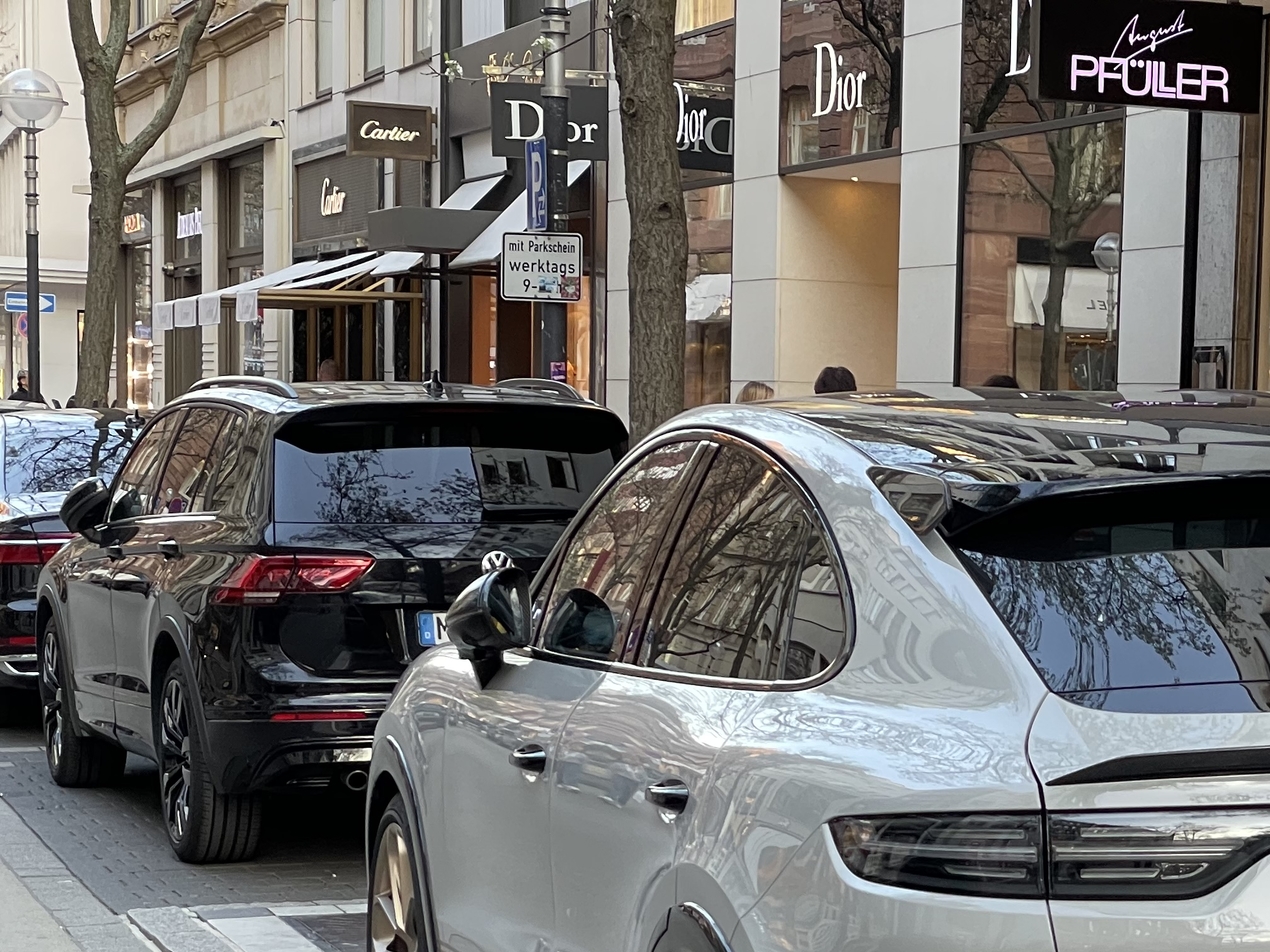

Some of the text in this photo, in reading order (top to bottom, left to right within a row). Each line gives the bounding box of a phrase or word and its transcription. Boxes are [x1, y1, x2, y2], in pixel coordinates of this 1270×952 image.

[813, 42, 866, 117] Dior
[1071, 54, 1229, 103] PFÜLLER
[360, 120, 420, 142] Cartier
[505, 100, 598, 143] Dor
[321, 178, 346, 217] Cartier
[509, 240, 576, 254] mit Parkschein
[509, 259, 575, 277] werktags
